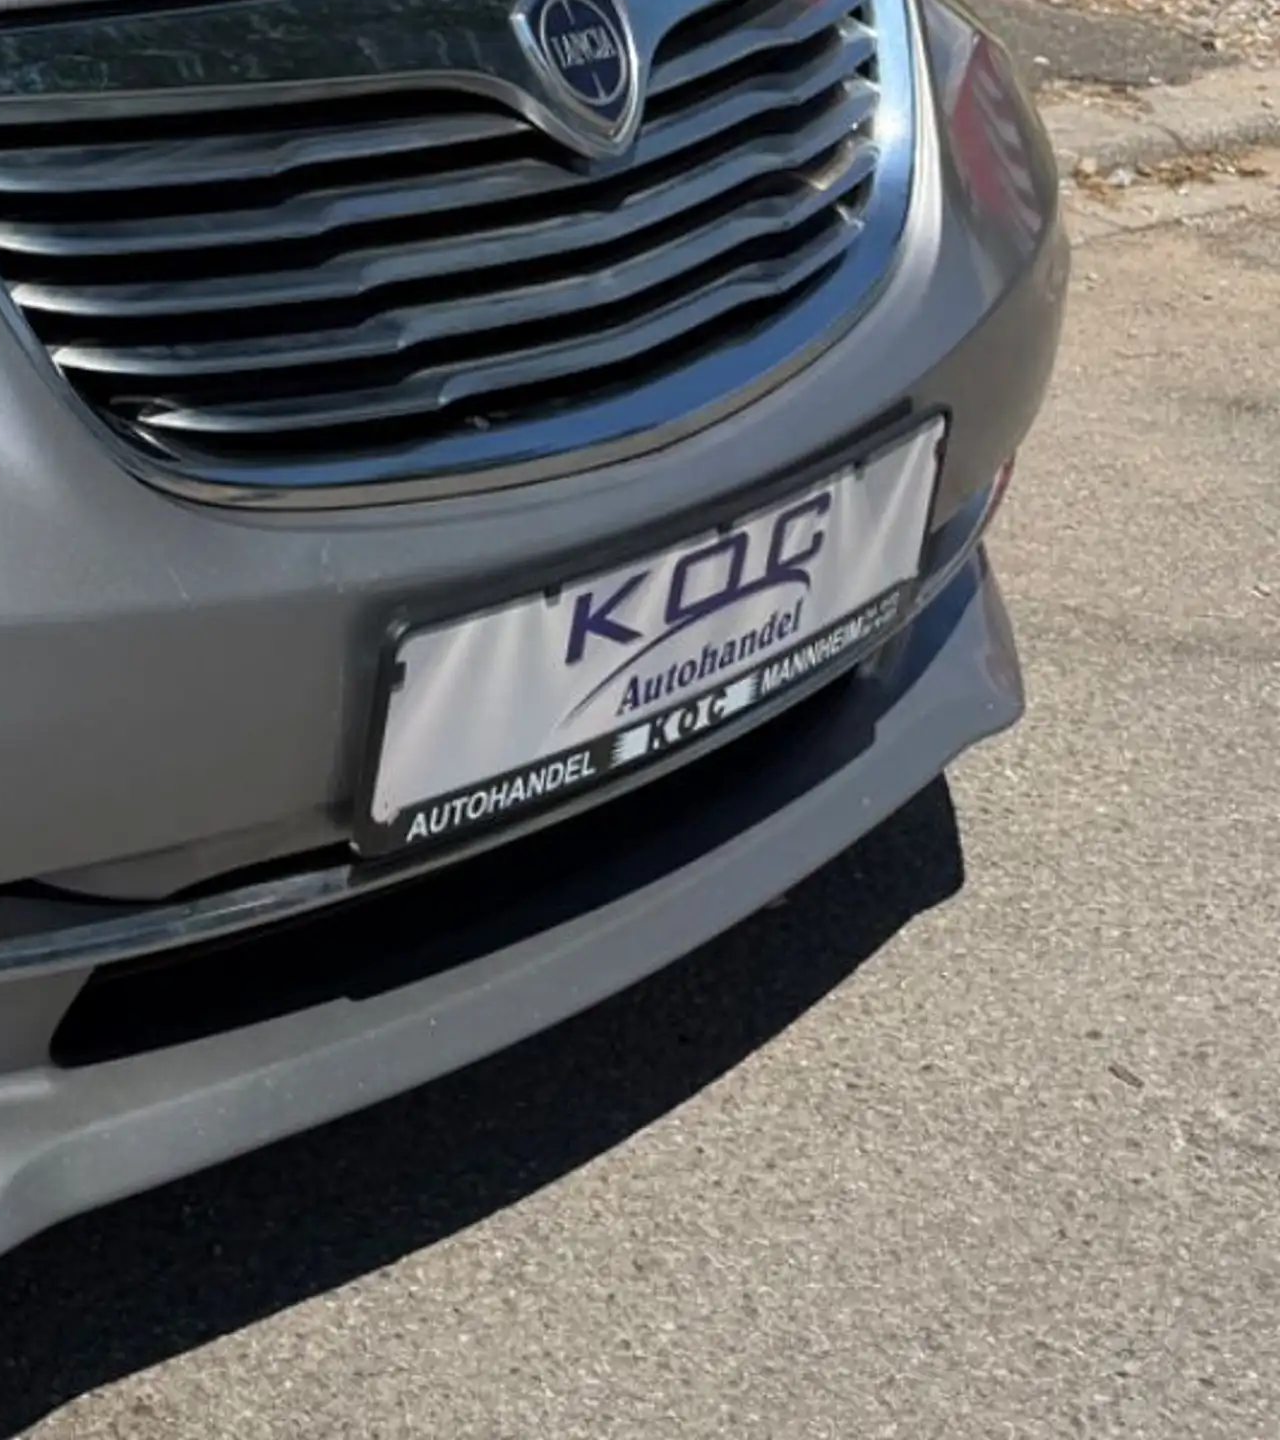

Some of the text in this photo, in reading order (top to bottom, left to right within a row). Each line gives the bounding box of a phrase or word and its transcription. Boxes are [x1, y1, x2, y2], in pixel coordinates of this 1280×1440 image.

[565, 491, 831, 665] KOC
[616, 596, 803, 717] Autohandel
[406, 750, 596, 842] AUTOHANDEL
[645, 682, 727, 755] KOC
